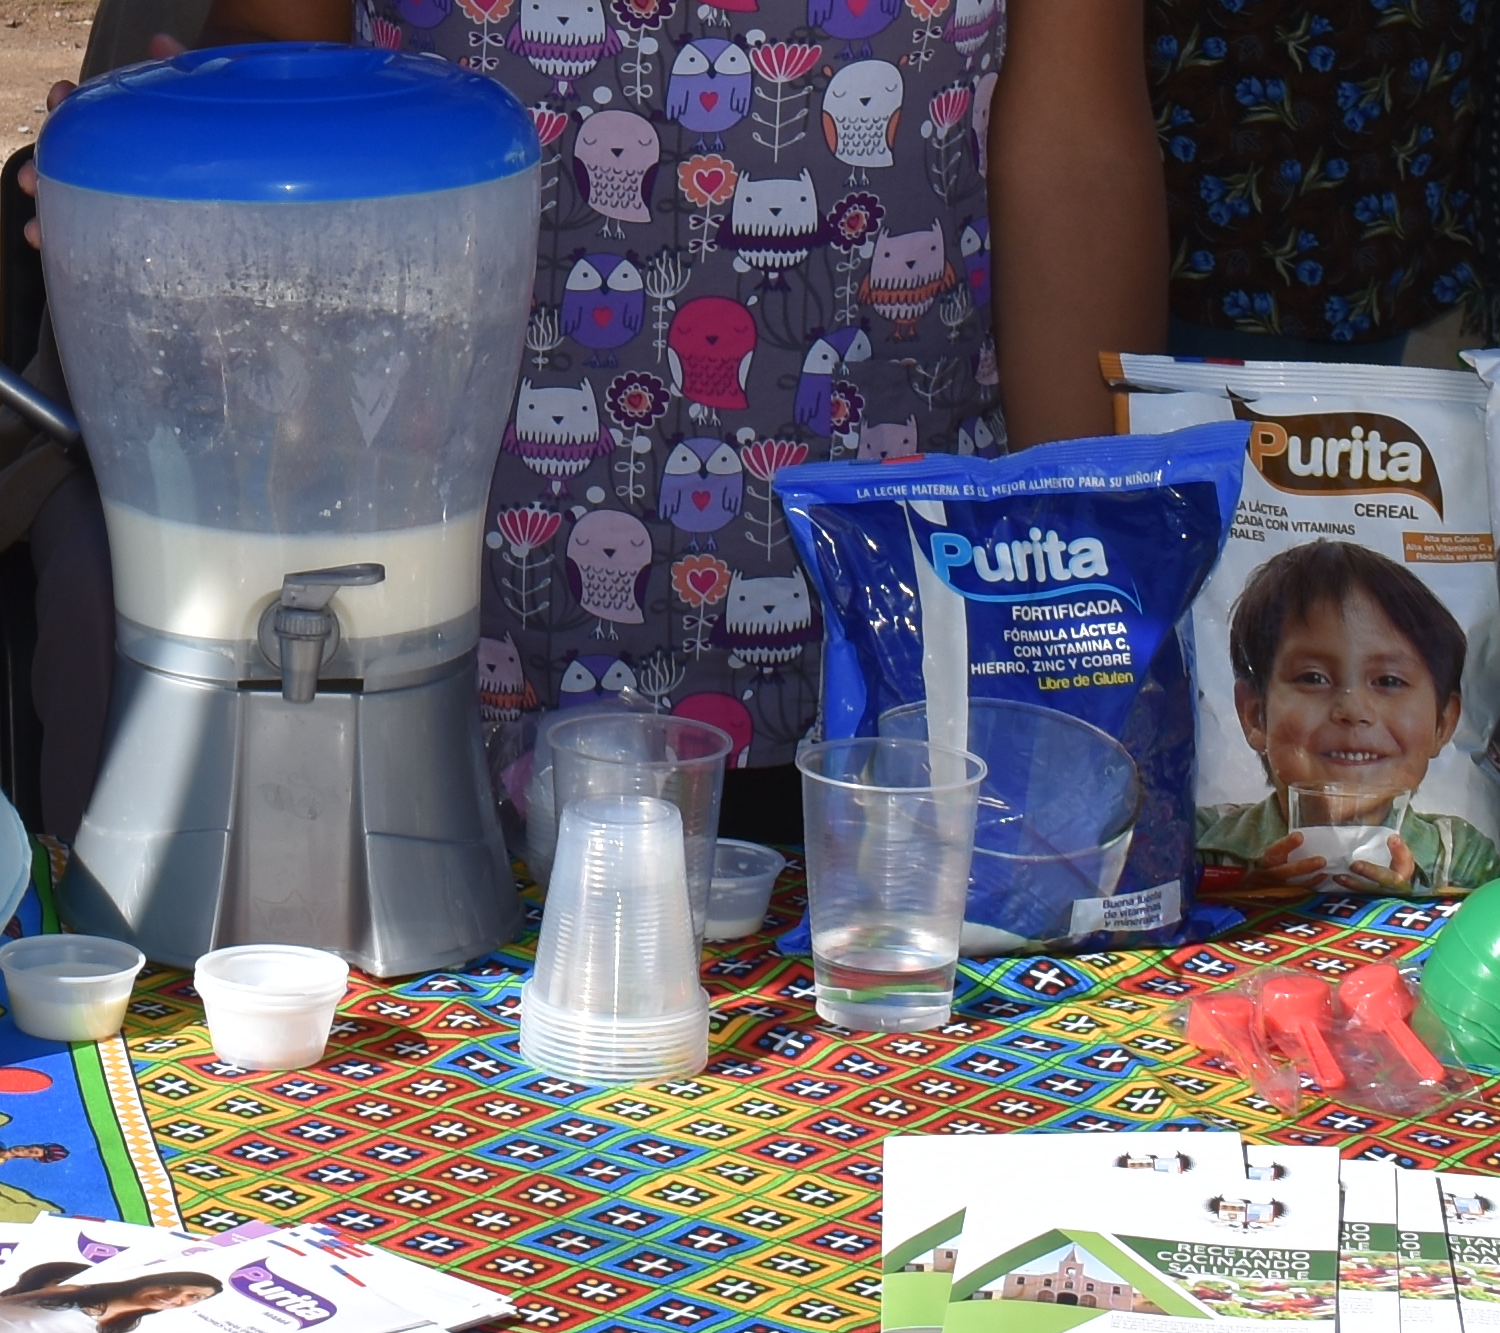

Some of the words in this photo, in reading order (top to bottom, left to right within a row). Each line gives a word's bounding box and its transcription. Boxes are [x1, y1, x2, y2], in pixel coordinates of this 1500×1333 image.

[1250, 421, 1423, 483] Purita
[874, 484, 908, 497] LECHE
[911, 482, 959, 496] MATERNA
[1078, 475, 1105, 488] PARA
[1247, 500, 1288, 517] LÁCTEA
[1353, 503, 1420, 520] CEREAL
[1291, 522, 1356, 536] VITAMINAS
[930, 527, 1110, 584] Purita
[1012, 598, 1123, 622] FORTIFICADA
[1003, 622, 1067, 643] FÓRMULA
[1071, 621, 1128, 639] LÁCTEA
[1013, 644, 1043, 658] CON
[1045, 639, 1112, 657] VITAMINA
[971, 661, 1030, 676] HIERRO,
[1033, 658, 1066, 673] ZINC
[1082, 653, 1132, 669] COBRE
[1092, 671, 1134, 687] Gluten
[1156, 1251, 1312, 1272] COCINANDO
[1175, 1241, 1312, 1262] RECETARIO
[1167, 1263, 1310, 1280] SALUDABLE
